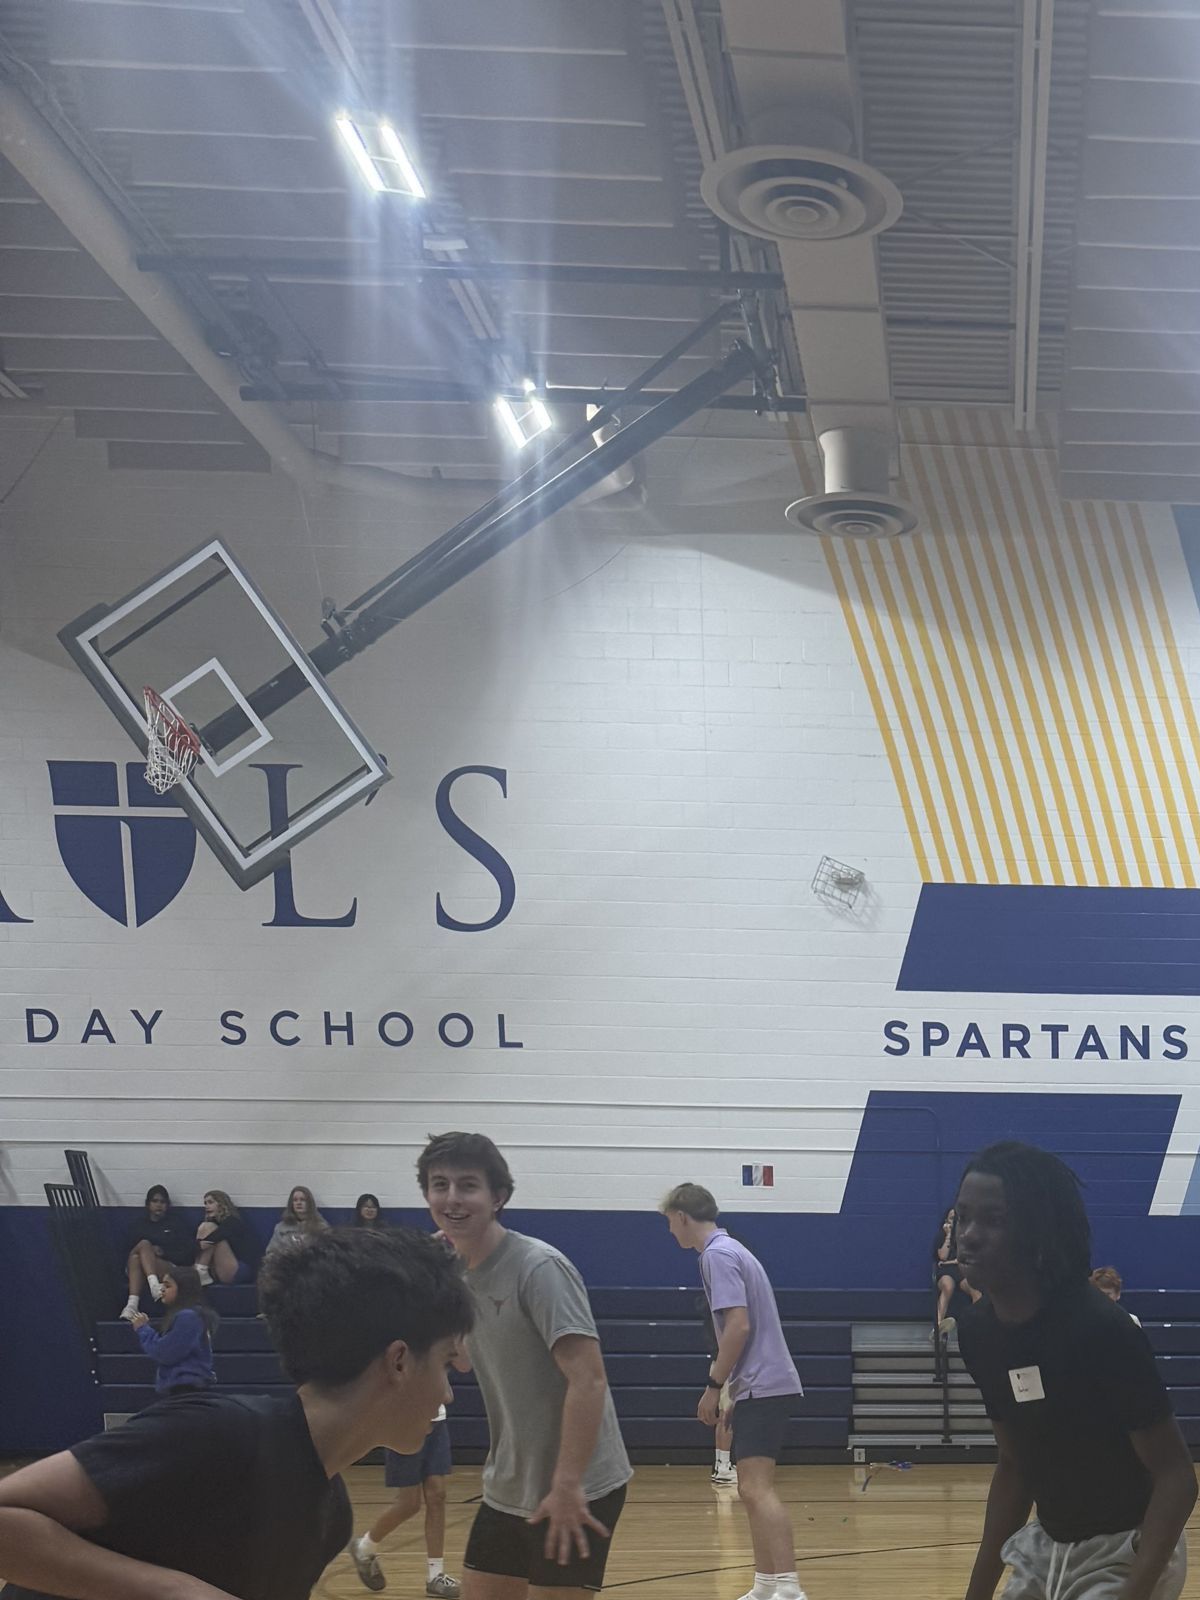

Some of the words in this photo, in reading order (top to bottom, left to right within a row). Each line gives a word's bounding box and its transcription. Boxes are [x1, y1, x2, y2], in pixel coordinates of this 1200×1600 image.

[25, 1008, 163, 1045] DAY
[220, 1009, 524, 1048] SCHOOL
[883, 1019, 1188, 1061] SPARTANS
